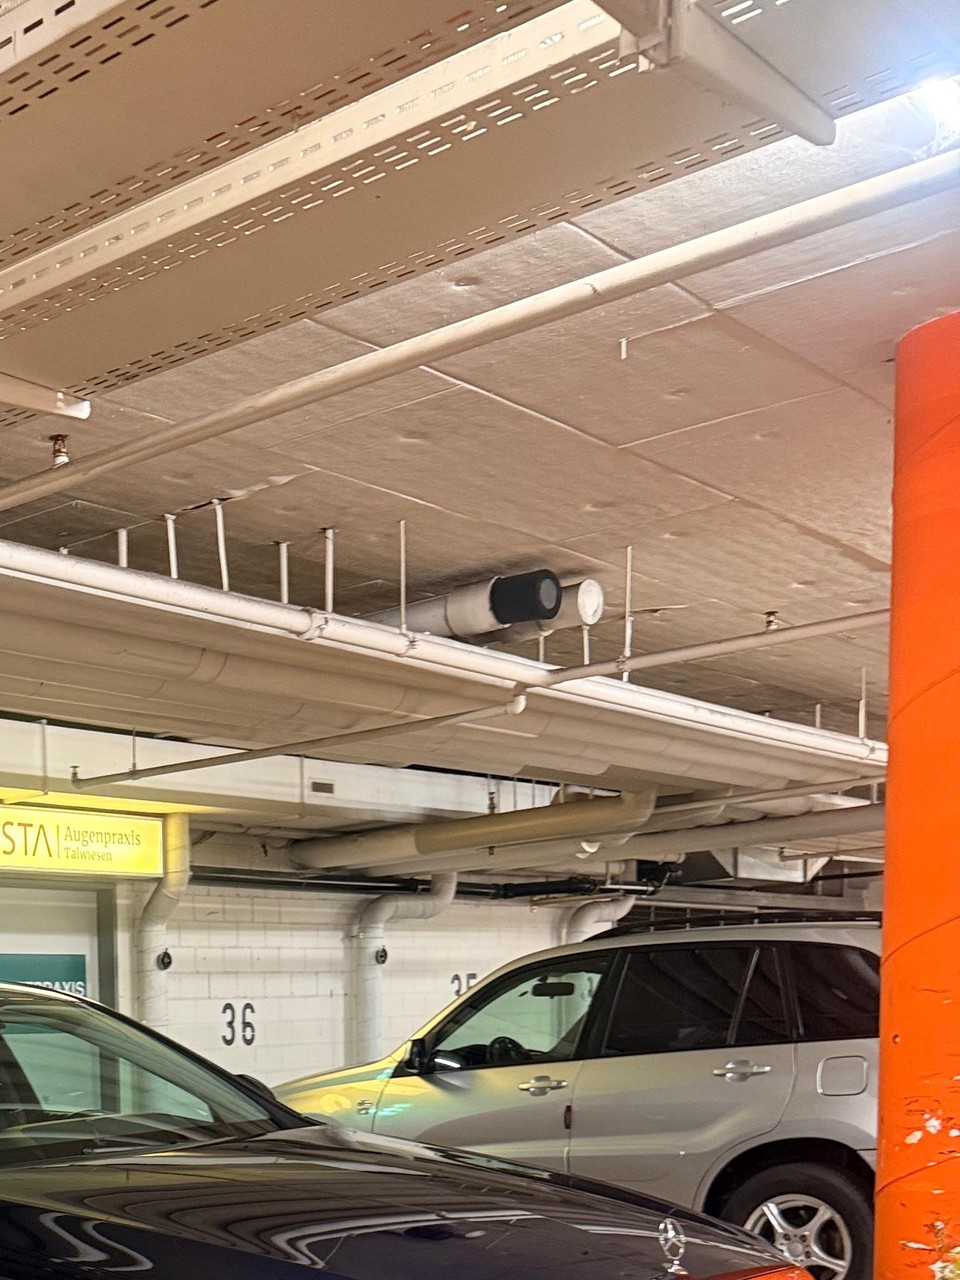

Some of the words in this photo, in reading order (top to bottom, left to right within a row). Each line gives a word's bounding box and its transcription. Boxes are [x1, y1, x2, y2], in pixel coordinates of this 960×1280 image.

[64, 825, 141, 848] Augenpraxis
[64, 846, 113, 861] Talwiesen
[221, 1002, 256, 1046] 36
